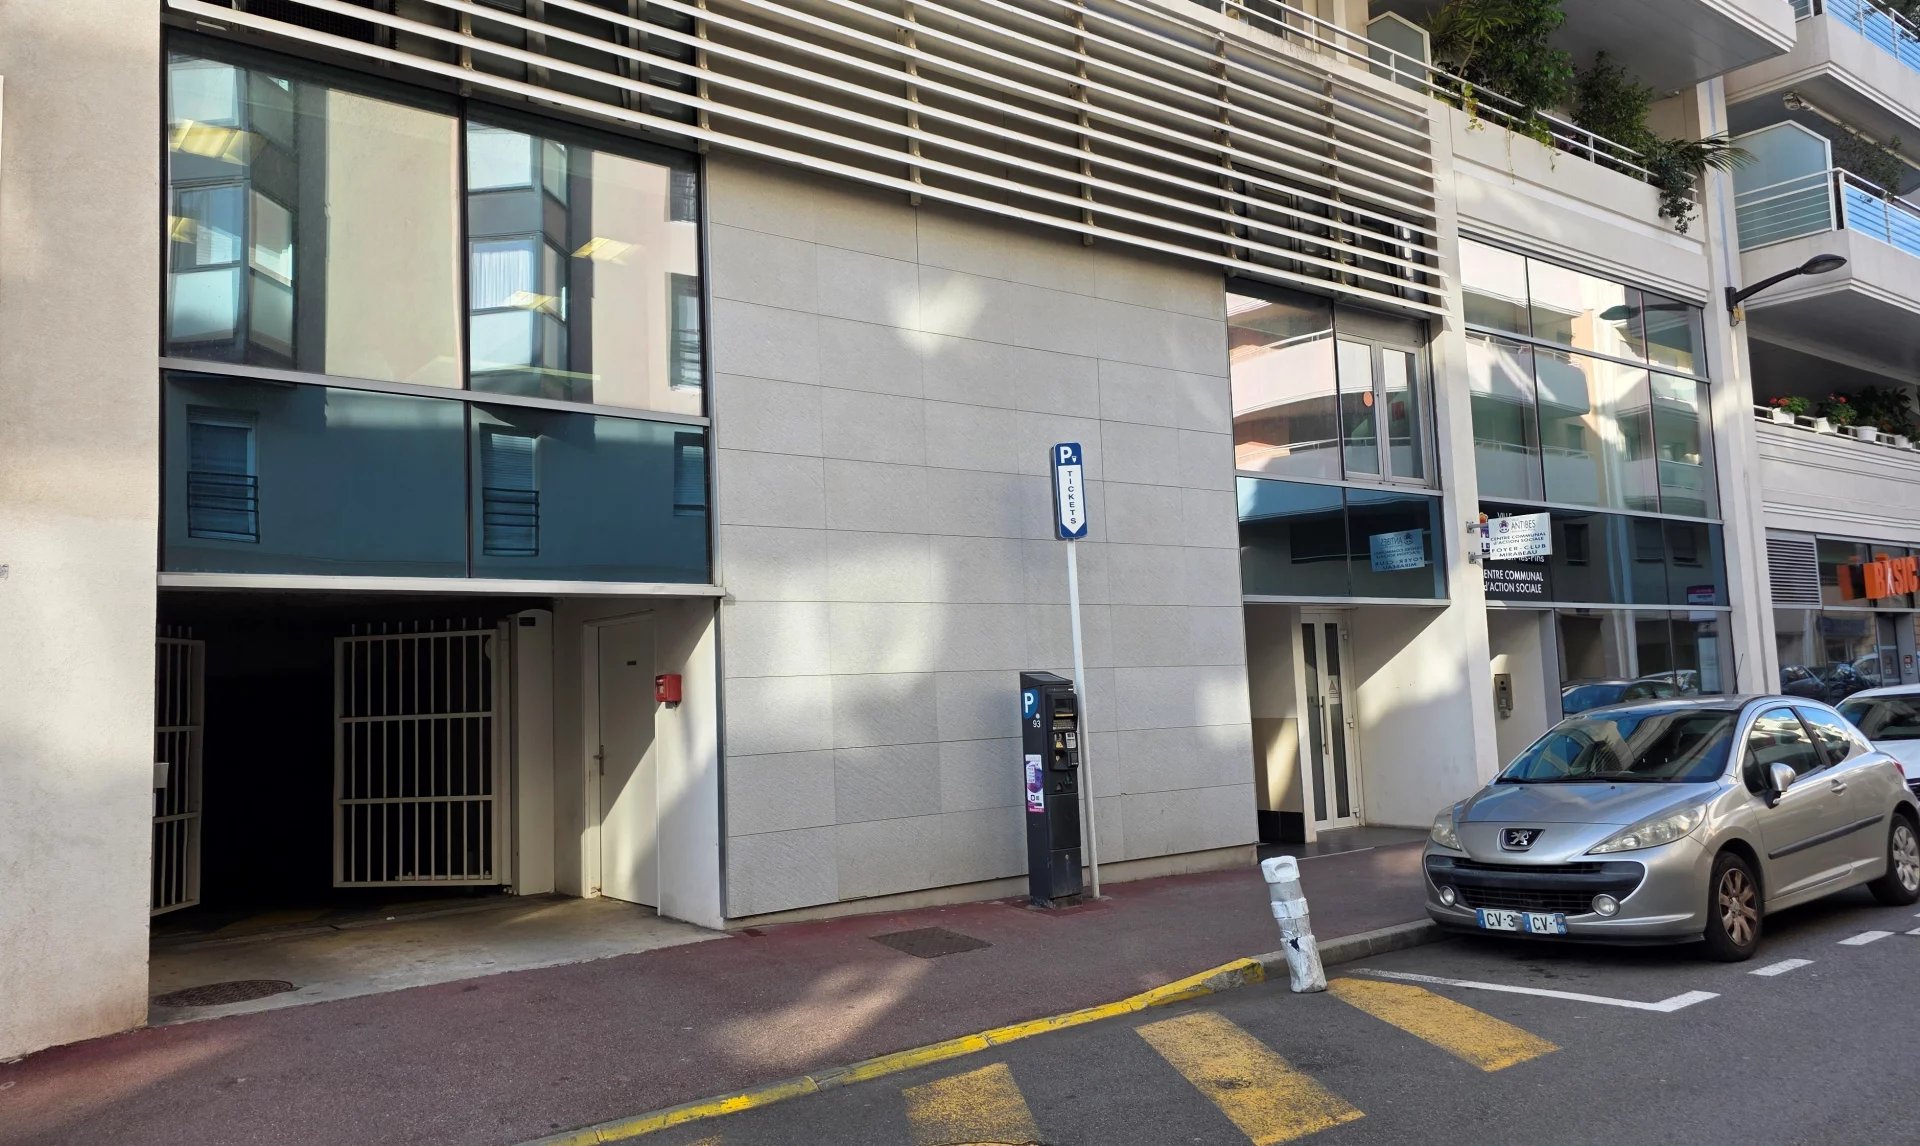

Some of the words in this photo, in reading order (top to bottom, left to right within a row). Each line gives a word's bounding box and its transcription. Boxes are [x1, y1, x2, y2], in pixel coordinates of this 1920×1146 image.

[1059, 446, 1073, 464] P
[1066, 470, 1077, 524] TICKETS
[1511, 520, 1536, 529] ANTIBES
[1483, 569, 1504, 580] ENTRE
[1504, 570, 1543, 581] COMMUNAL
[1873, 556, 1918, 599] BASIC
[1483, 581, 1515, 593] d'ACTION
[1516, 583, 1542, 594] SOCIALE
[1024, 692, 1035, 714] P
[1032, 719, 1041, 728] 93
